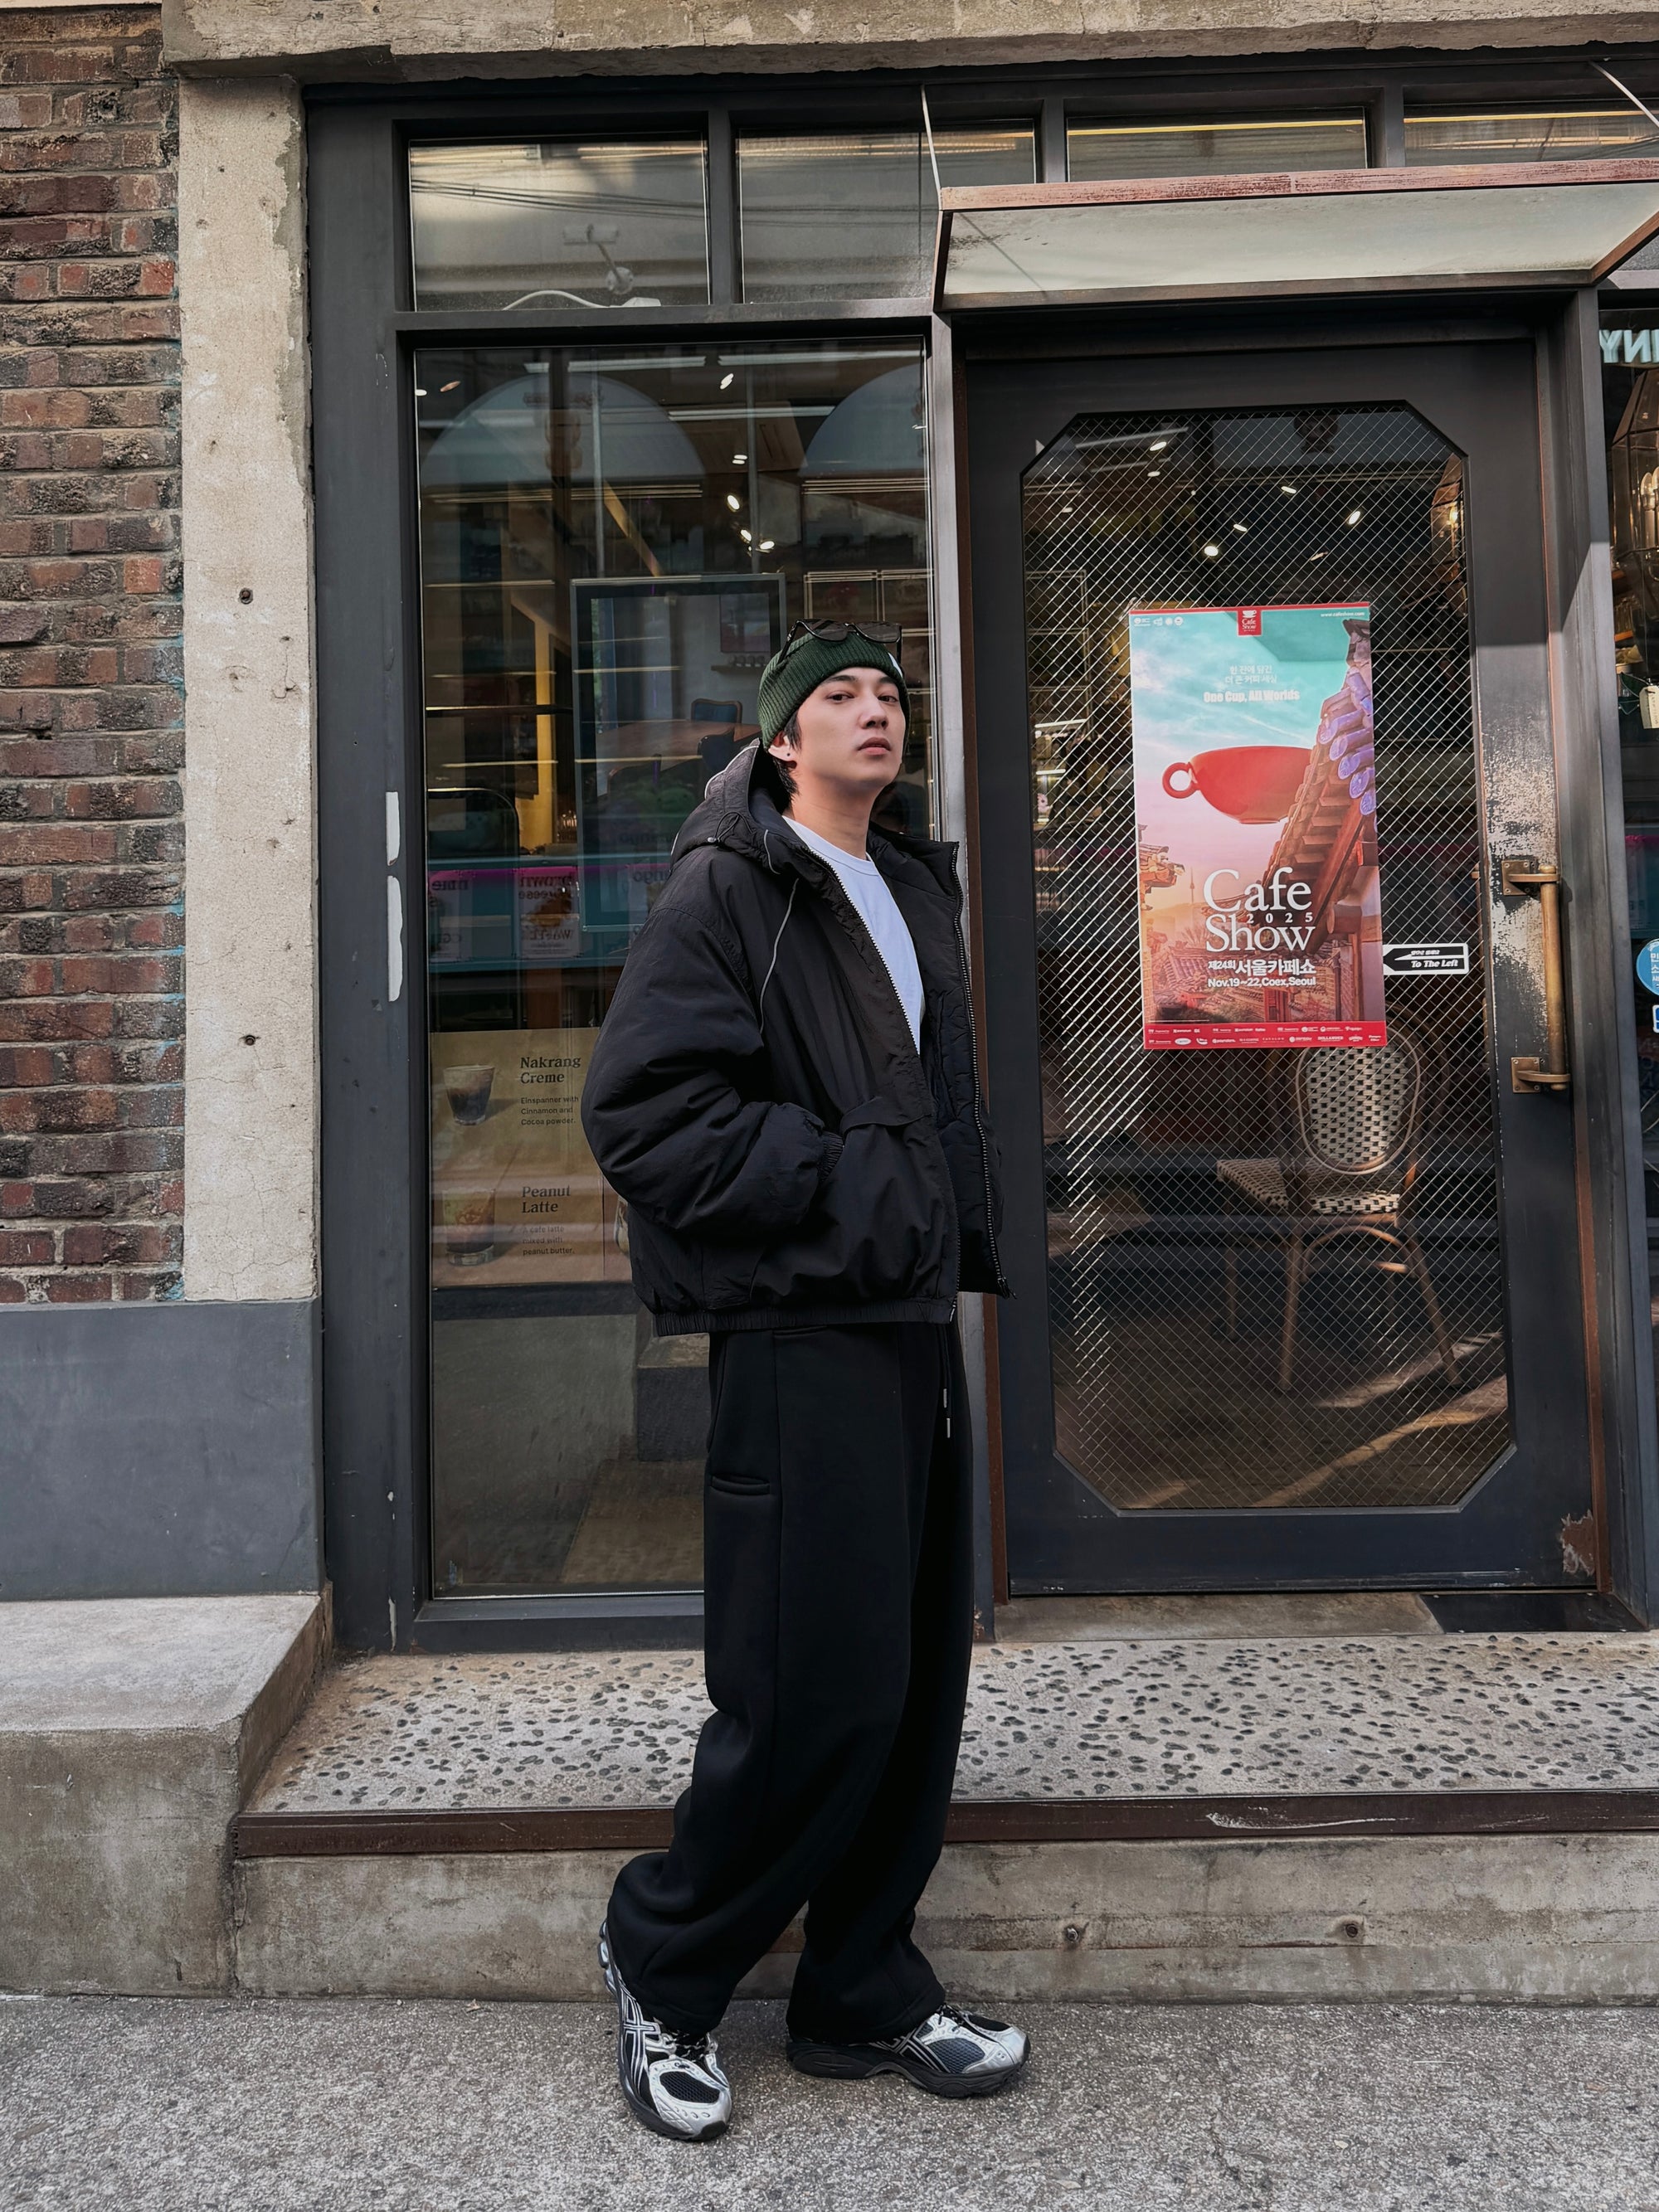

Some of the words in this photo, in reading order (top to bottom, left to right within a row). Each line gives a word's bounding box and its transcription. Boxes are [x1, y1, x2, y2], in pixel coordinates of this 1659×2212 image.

[1203, 692, 1224, 702] One
[1224, 691, 1248, 702] Cup,
[1248, 690, 1262, 702] All
[1262, 689, 1300, 702] Worlds
[1204, 867, 1312, 912] Cafe
[1247, 912, 1313, 924] 2025
[1205, 914, 1316, 952] Show
[1235, 959, 1317, 977] 서울카페쇼
[1423, 960, 1440, 968] The
[1441, 959, 1458, 967] Left
[520, 1057, 581, 1068] Nakrang
[520, 1072, 565, 1084] Creme
[522, 1184, 571, 1198] Peanut
[522, 1201, 558, 1213] Latte
[523, 1248, 549, 1257] peanut
